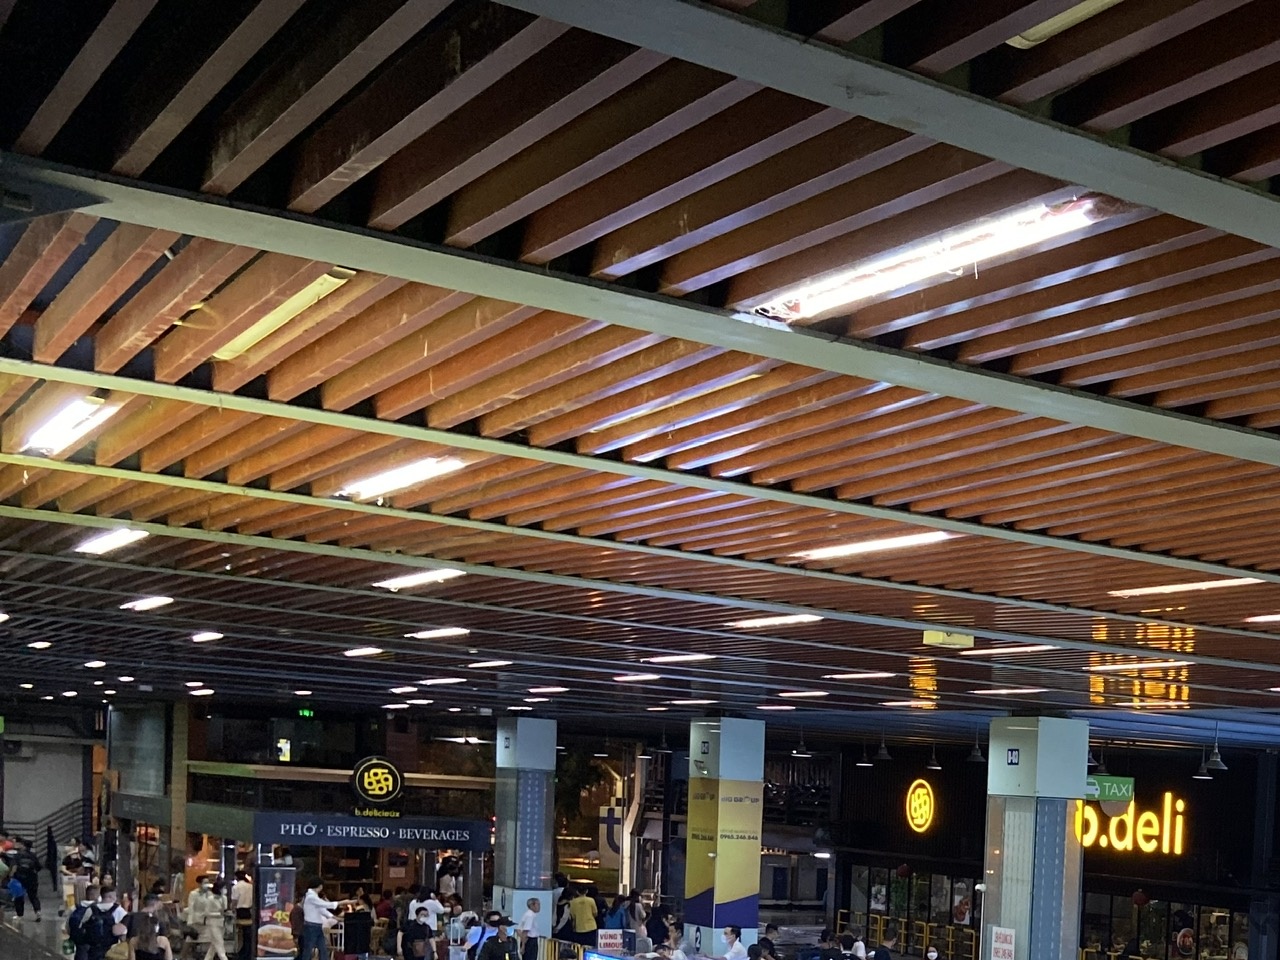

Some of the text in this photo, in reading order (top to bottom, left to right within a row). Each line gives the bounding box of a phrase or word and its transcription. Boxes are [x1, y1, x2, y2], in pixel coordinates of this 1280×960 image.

[1103, 782, 1133, 797] TAXI
[280, 821, 470, 841] PHỞ ESPRESSO BEVERAGES
